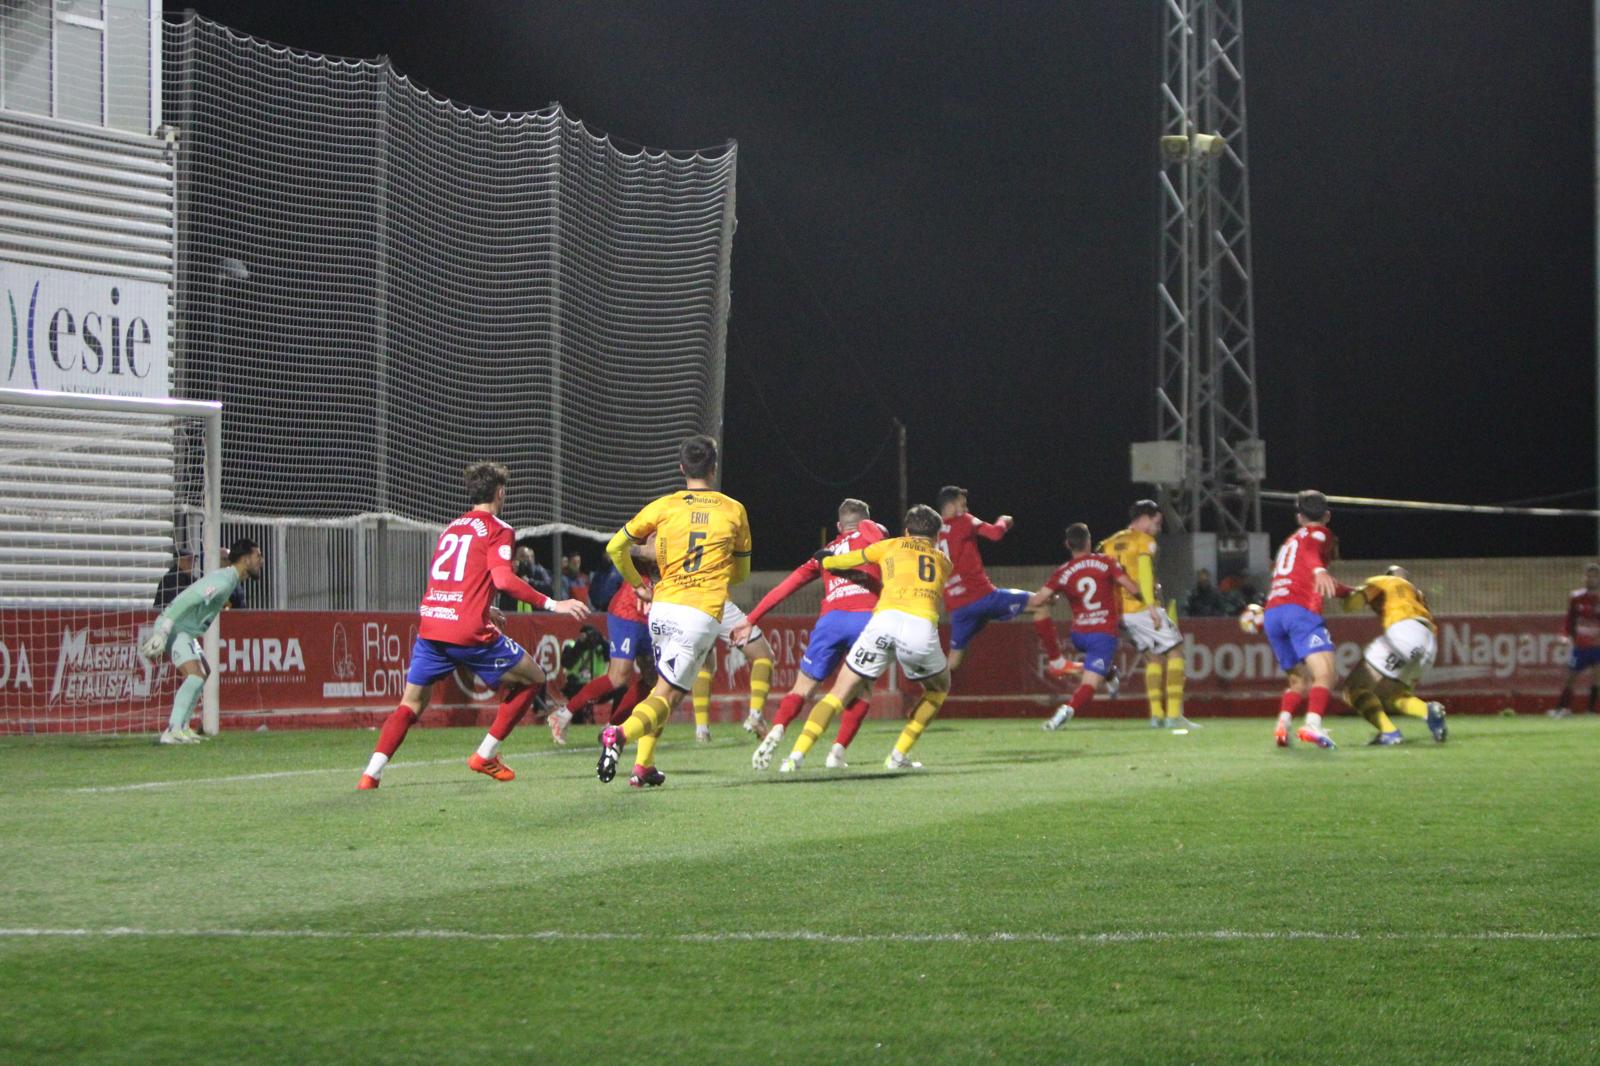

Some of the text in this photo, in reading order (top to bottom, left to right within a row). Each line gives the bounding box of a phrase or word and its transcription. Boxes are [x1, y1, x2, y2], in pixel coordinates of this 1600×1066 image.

[691, 511, 710, 525] ERIK
[431, 533, 473, 582] 21
[682, 531, 708, 573] 5
[918, 554, 936, 583] 6
[1077, 576, 1102, 610] 2
[620, 637, 632, 656] 4
